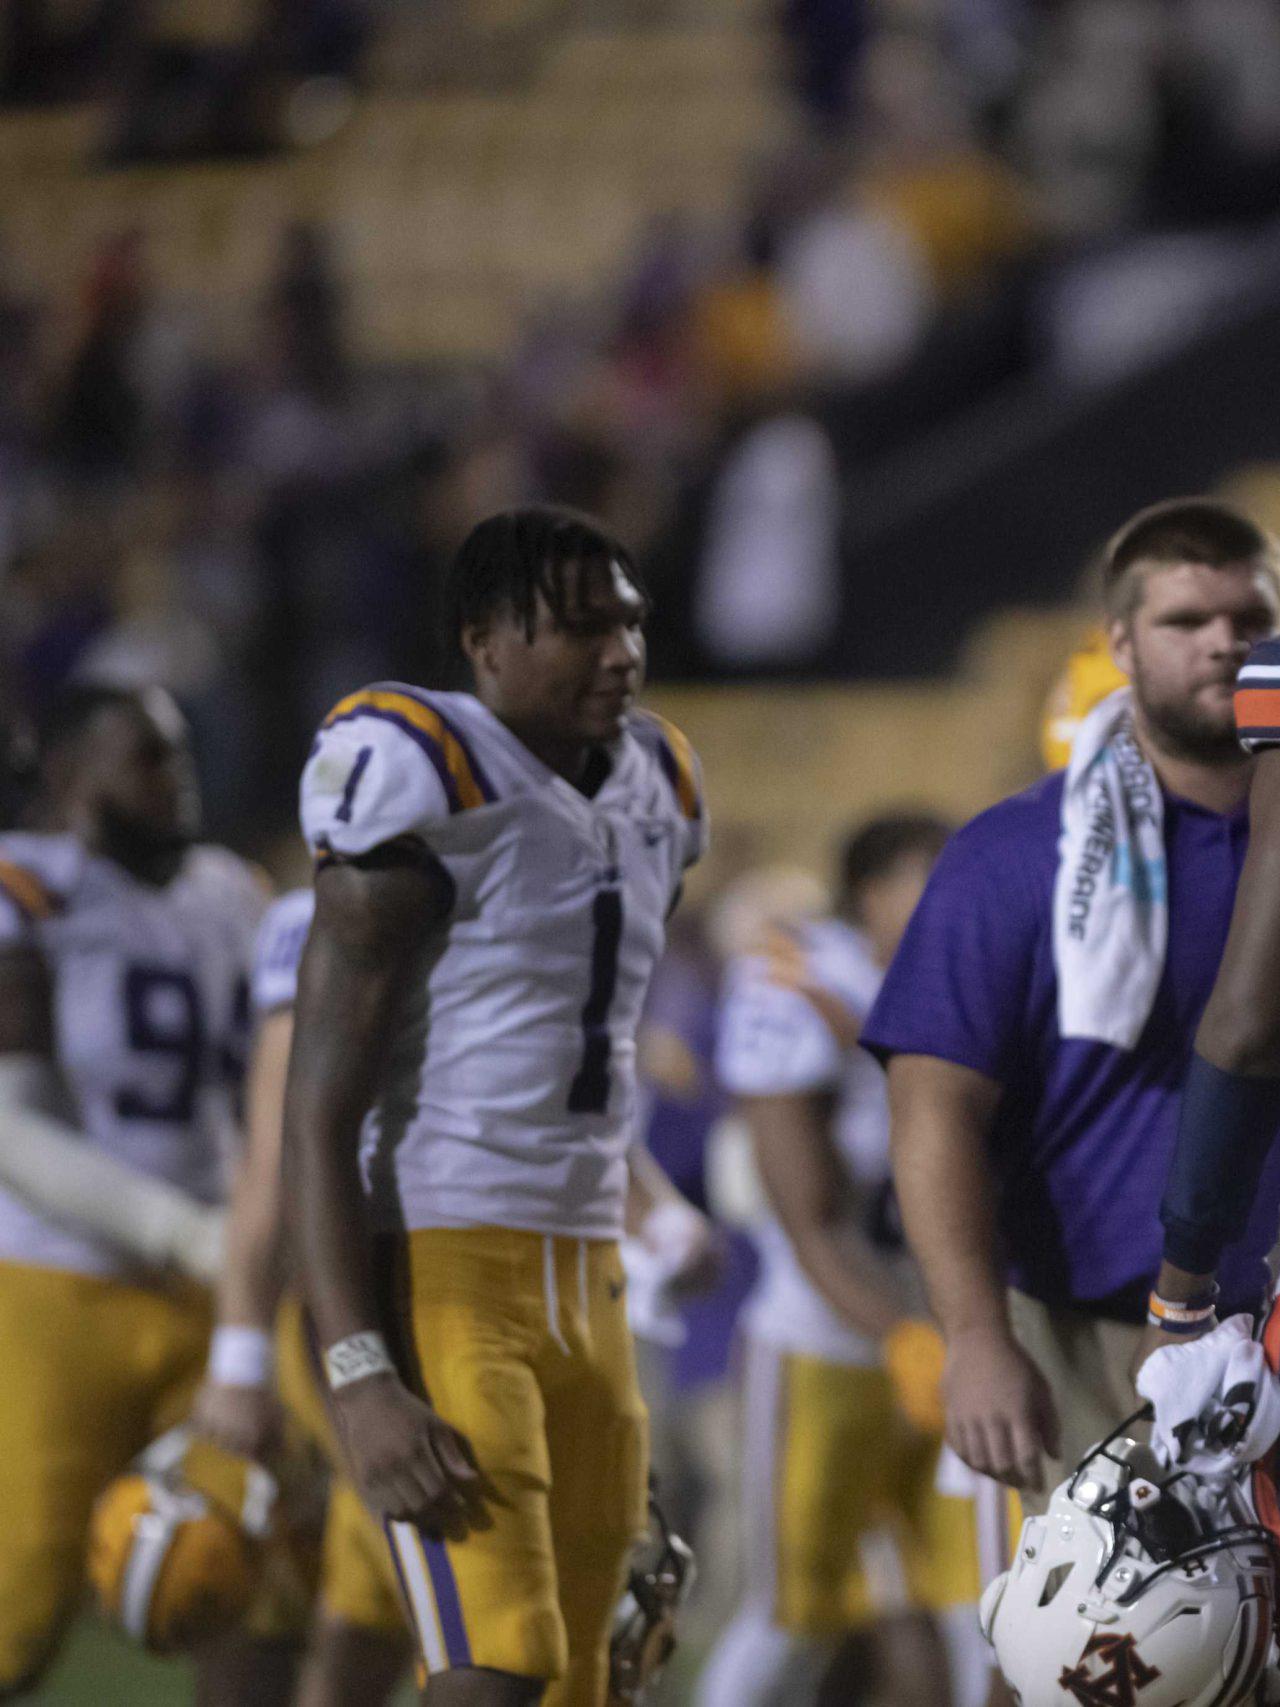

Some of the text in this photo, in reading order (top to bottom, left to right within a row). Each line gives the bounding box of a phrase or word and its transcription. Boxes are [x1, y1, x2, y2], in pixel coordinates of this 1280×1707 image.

[335, 745, 374, 824] 1
[1067, 772, 1119, 942] WERADE
[567, 889, 624, 1114] 1
